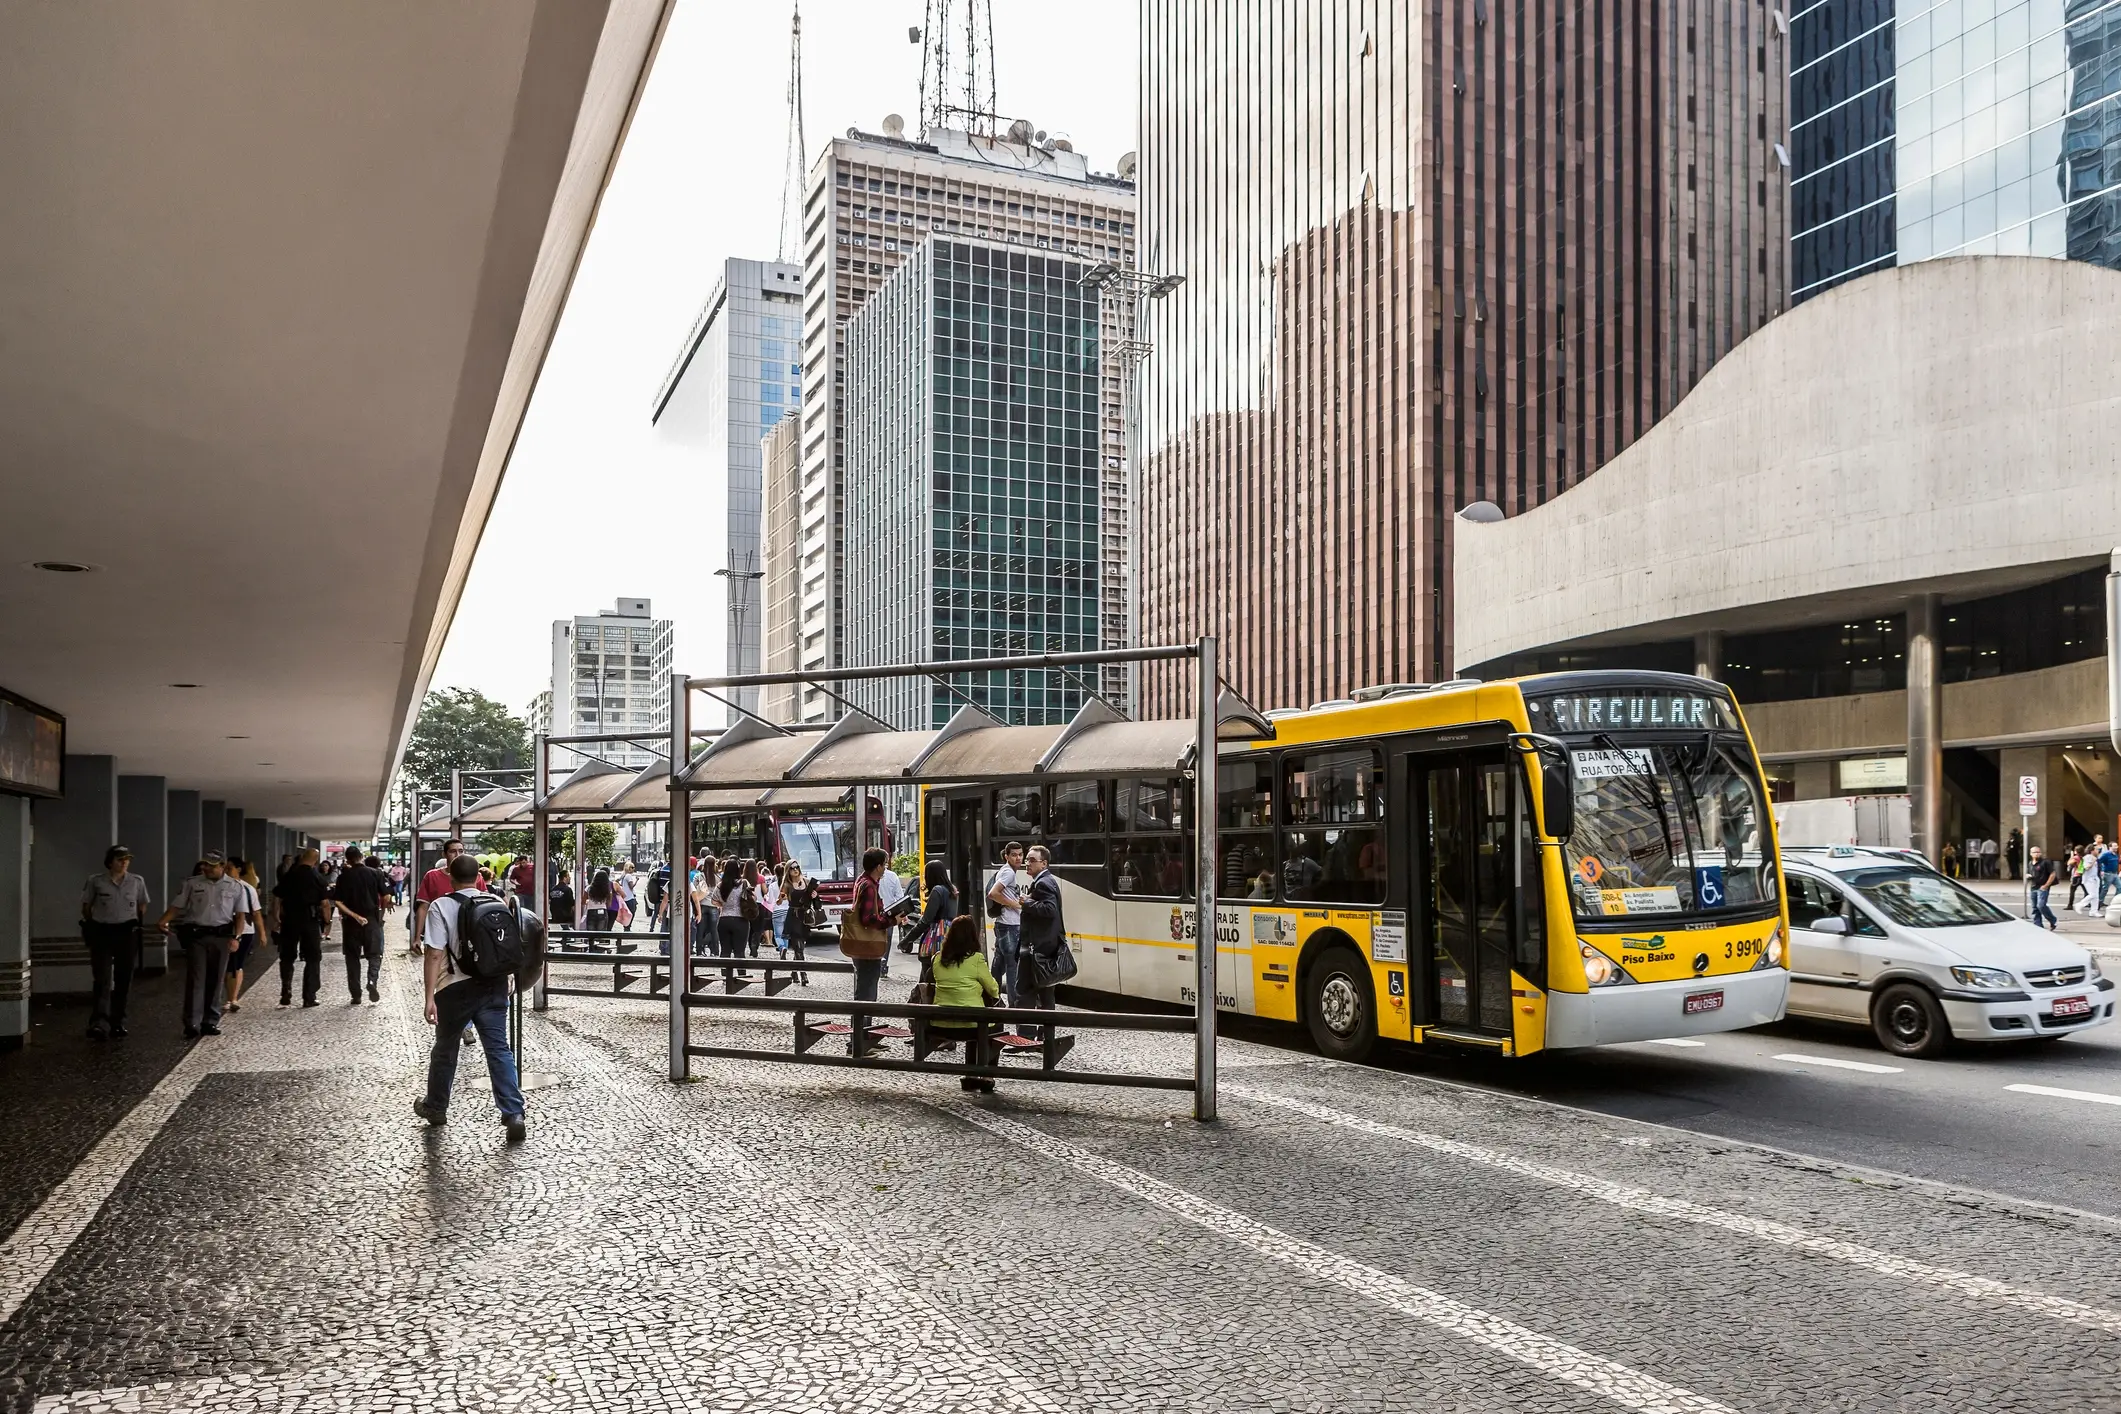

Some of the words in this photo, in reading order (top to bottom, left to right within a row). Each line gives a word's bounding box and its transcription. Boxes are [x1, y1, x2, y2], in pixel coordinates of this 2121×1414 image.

[1553, 698, 1704, 723] CIRCULAR
[1588, 751, 1611, 762] ANA
[1612, 750, 1642, 761] RSA
[1581, 765, 1604, 776] RUA
[1605, 764, 1649, 775] TOPAIO
[1585, 861, 1596, 878] 3
[1229, 913, 1239, 924] DE
[1283, 920, 1297, 932] Plus
[1724, 942, 1733, 959] 3
[1736, 938, 1763, 957] 9910
[1622, 954, 1645, 965] Piso
[1647, 951, 1675, 963] Baixo
